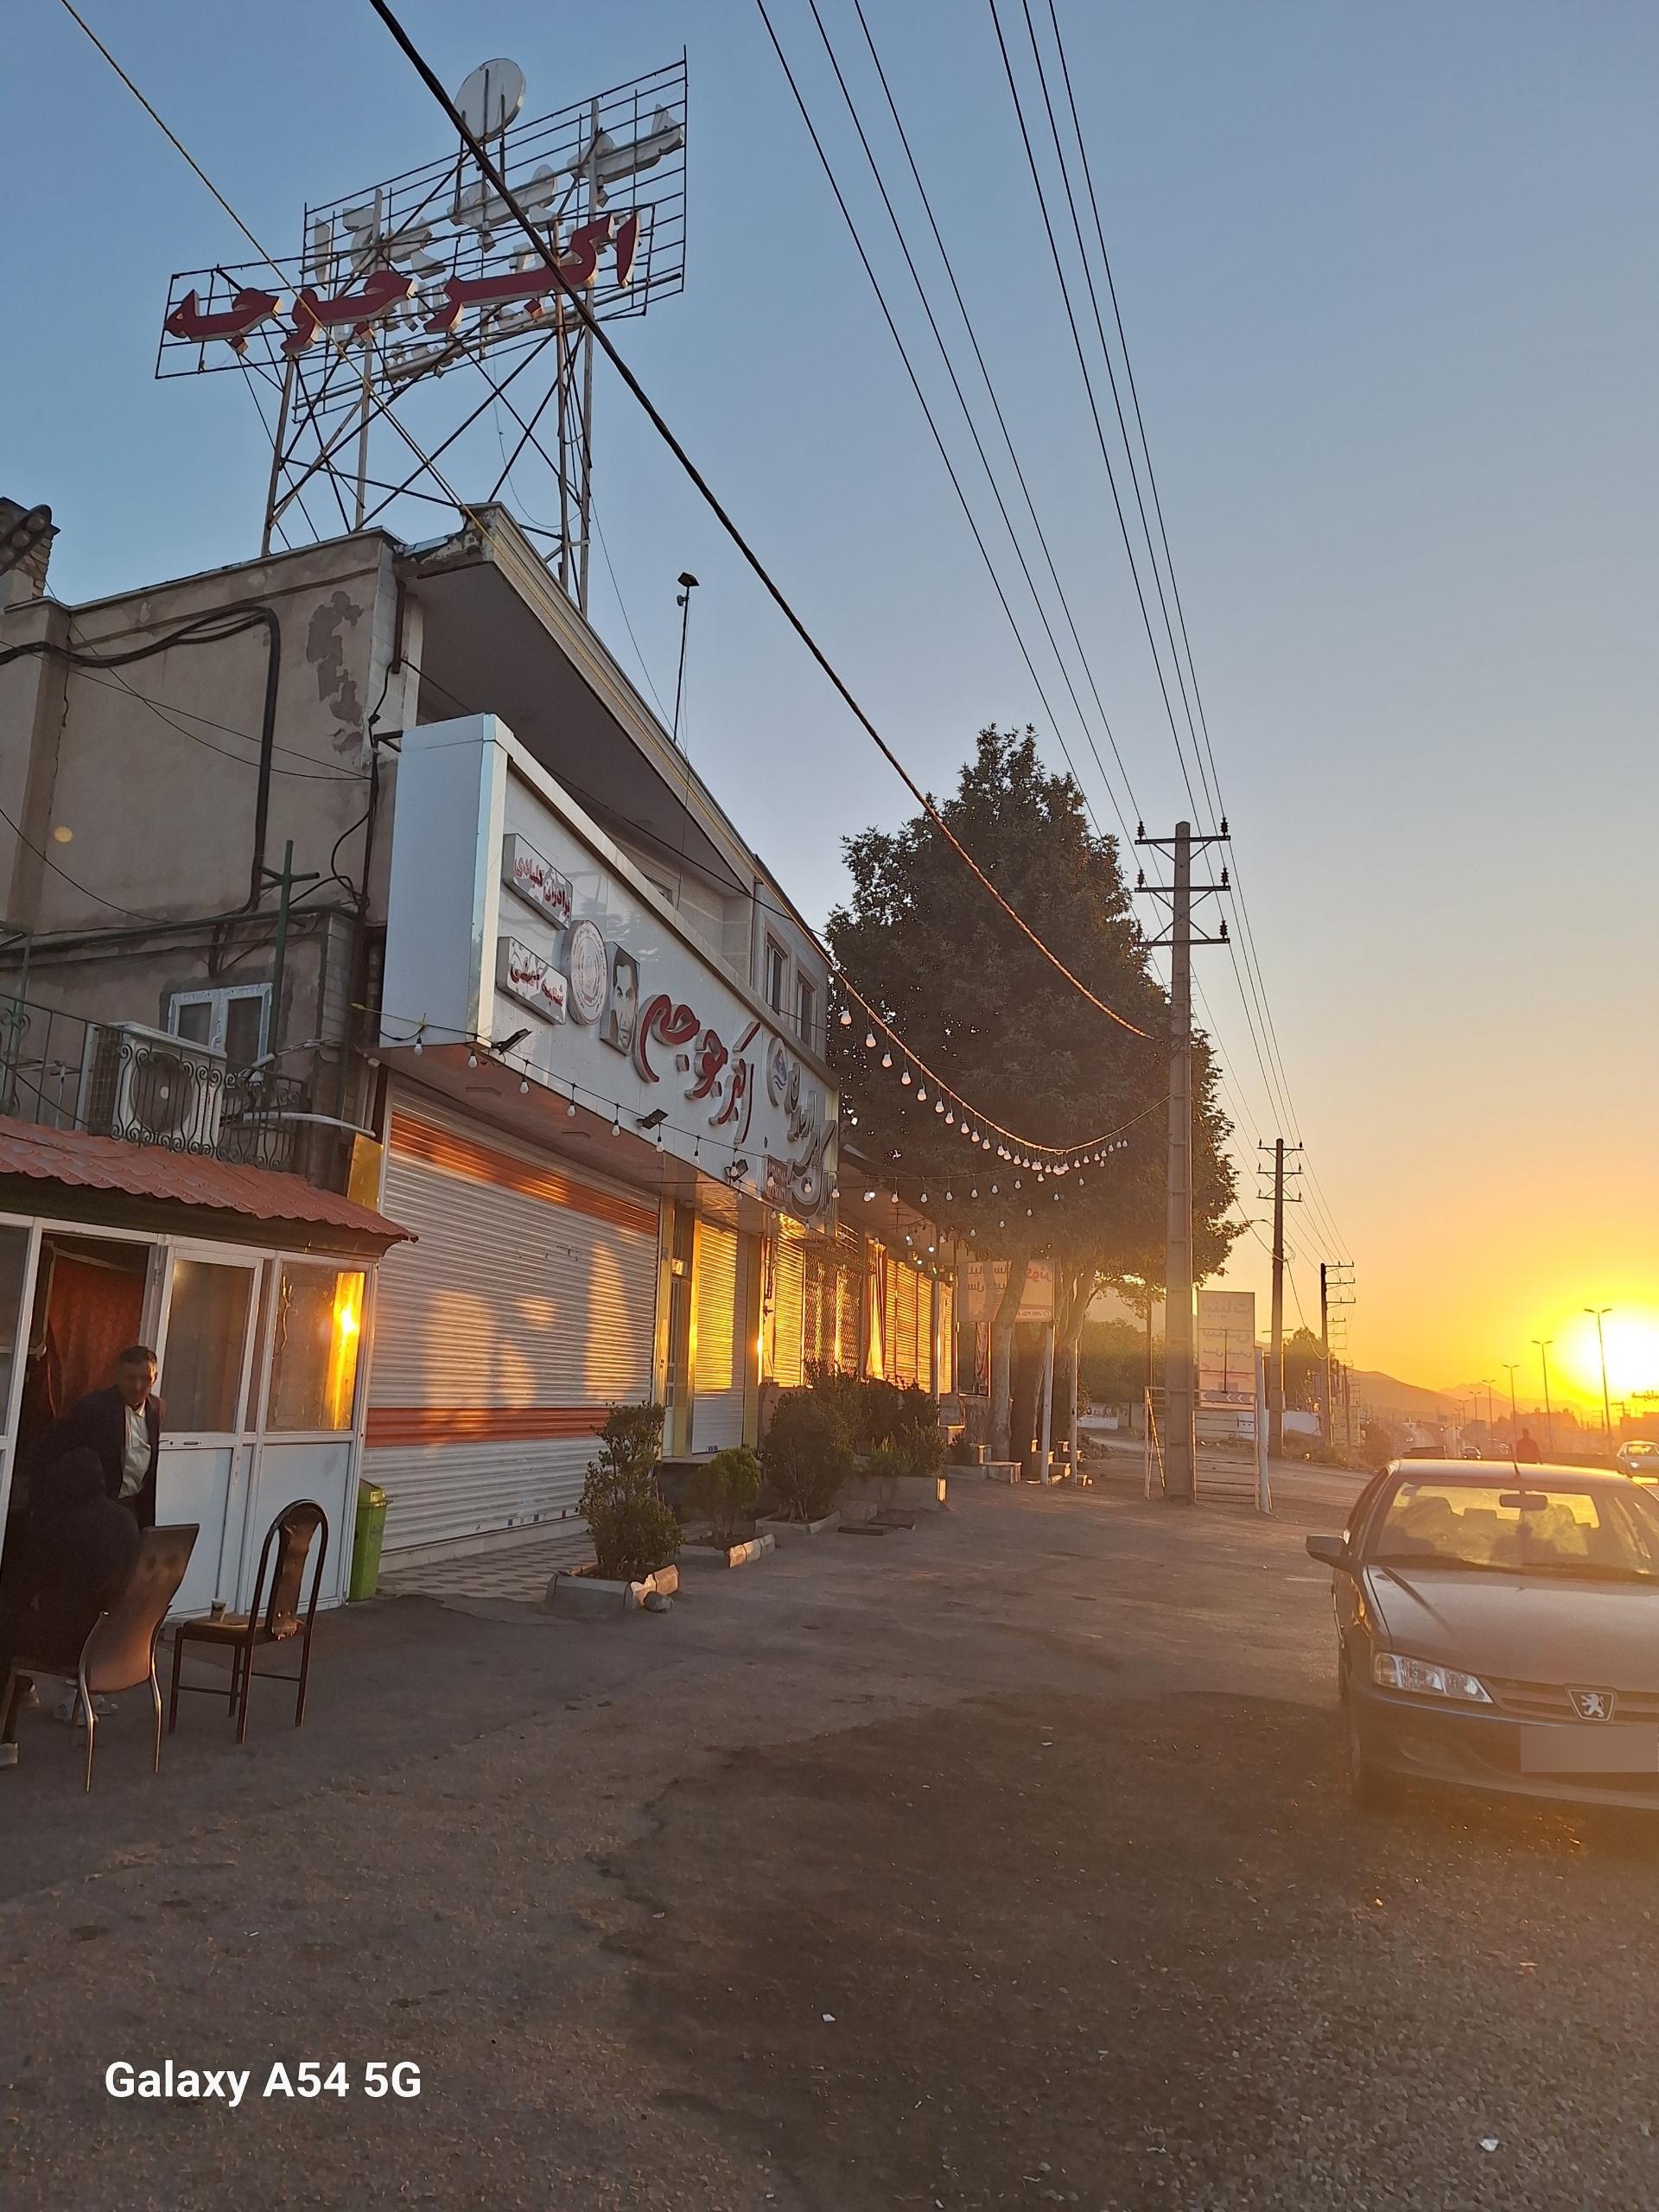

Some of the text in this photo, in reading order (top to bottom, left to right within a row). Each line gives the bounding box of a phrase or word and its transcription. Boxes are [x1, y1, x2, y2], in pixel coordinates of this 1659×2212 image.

[163, 269, 418, 359] جوجه
[423, 210, 641, 335] اکبر
[543, 879, 570, 918] برادران
[541, 980, 563, 1007] شعبه
[632, 994, 728, 1100] جوجه
[709, 1021, 761, 1144] اکبر
